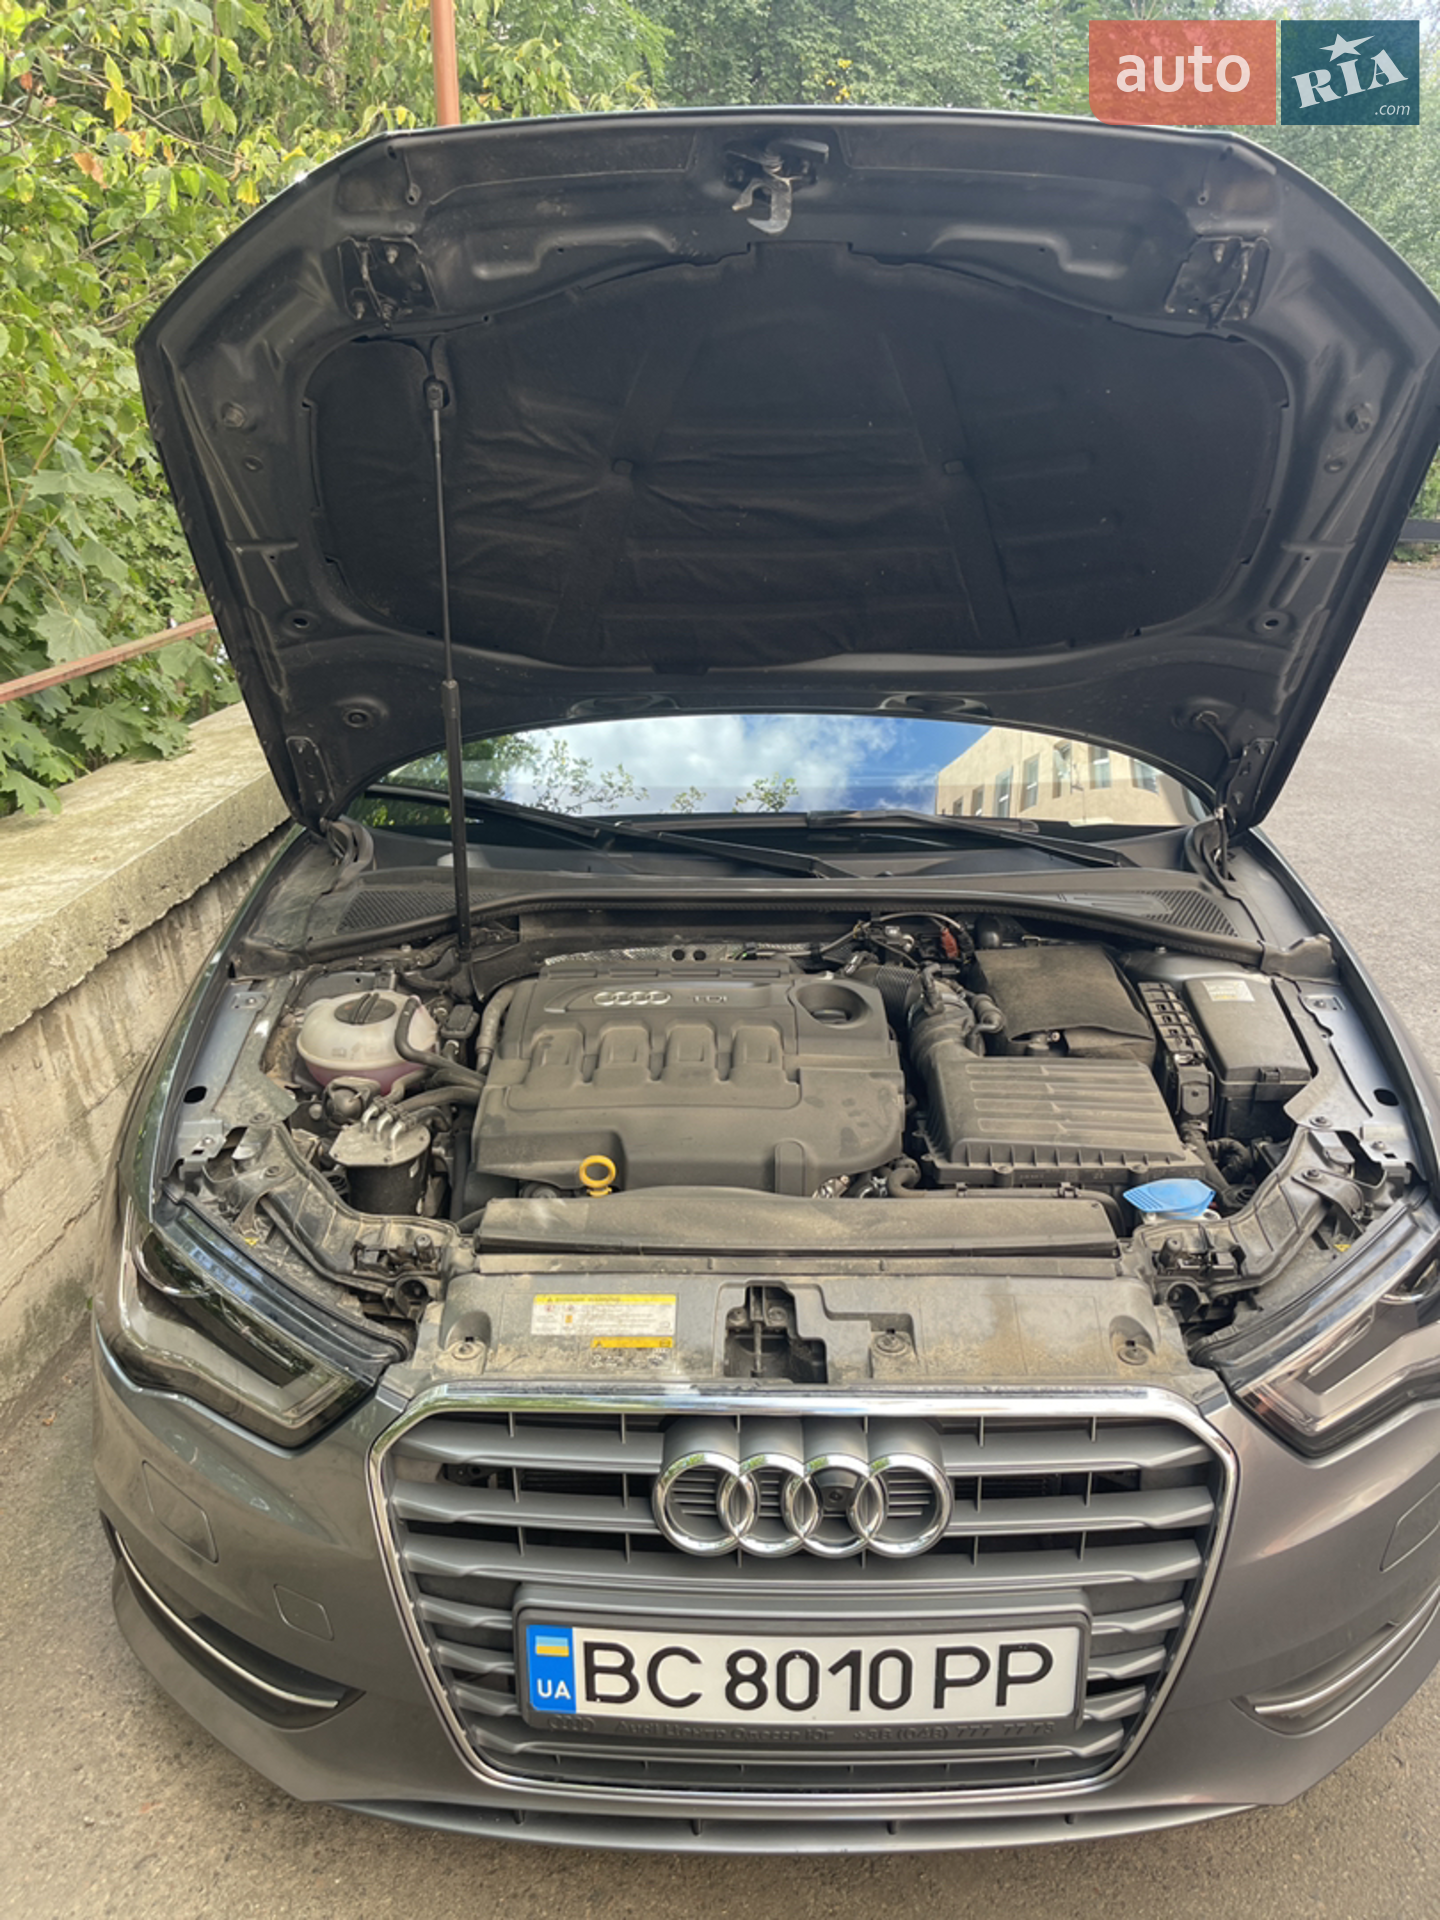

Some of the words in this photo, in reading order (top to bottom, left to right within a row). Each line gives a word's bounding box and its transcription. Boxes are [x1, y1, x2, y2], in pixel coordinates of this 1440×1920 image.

[537, 1678, 571, 1700] UA
[583, 1641, 703, 1708] BC
[725, 1649, 913, 1712] 8010
[933, 1643, 1053, 1710] PP
